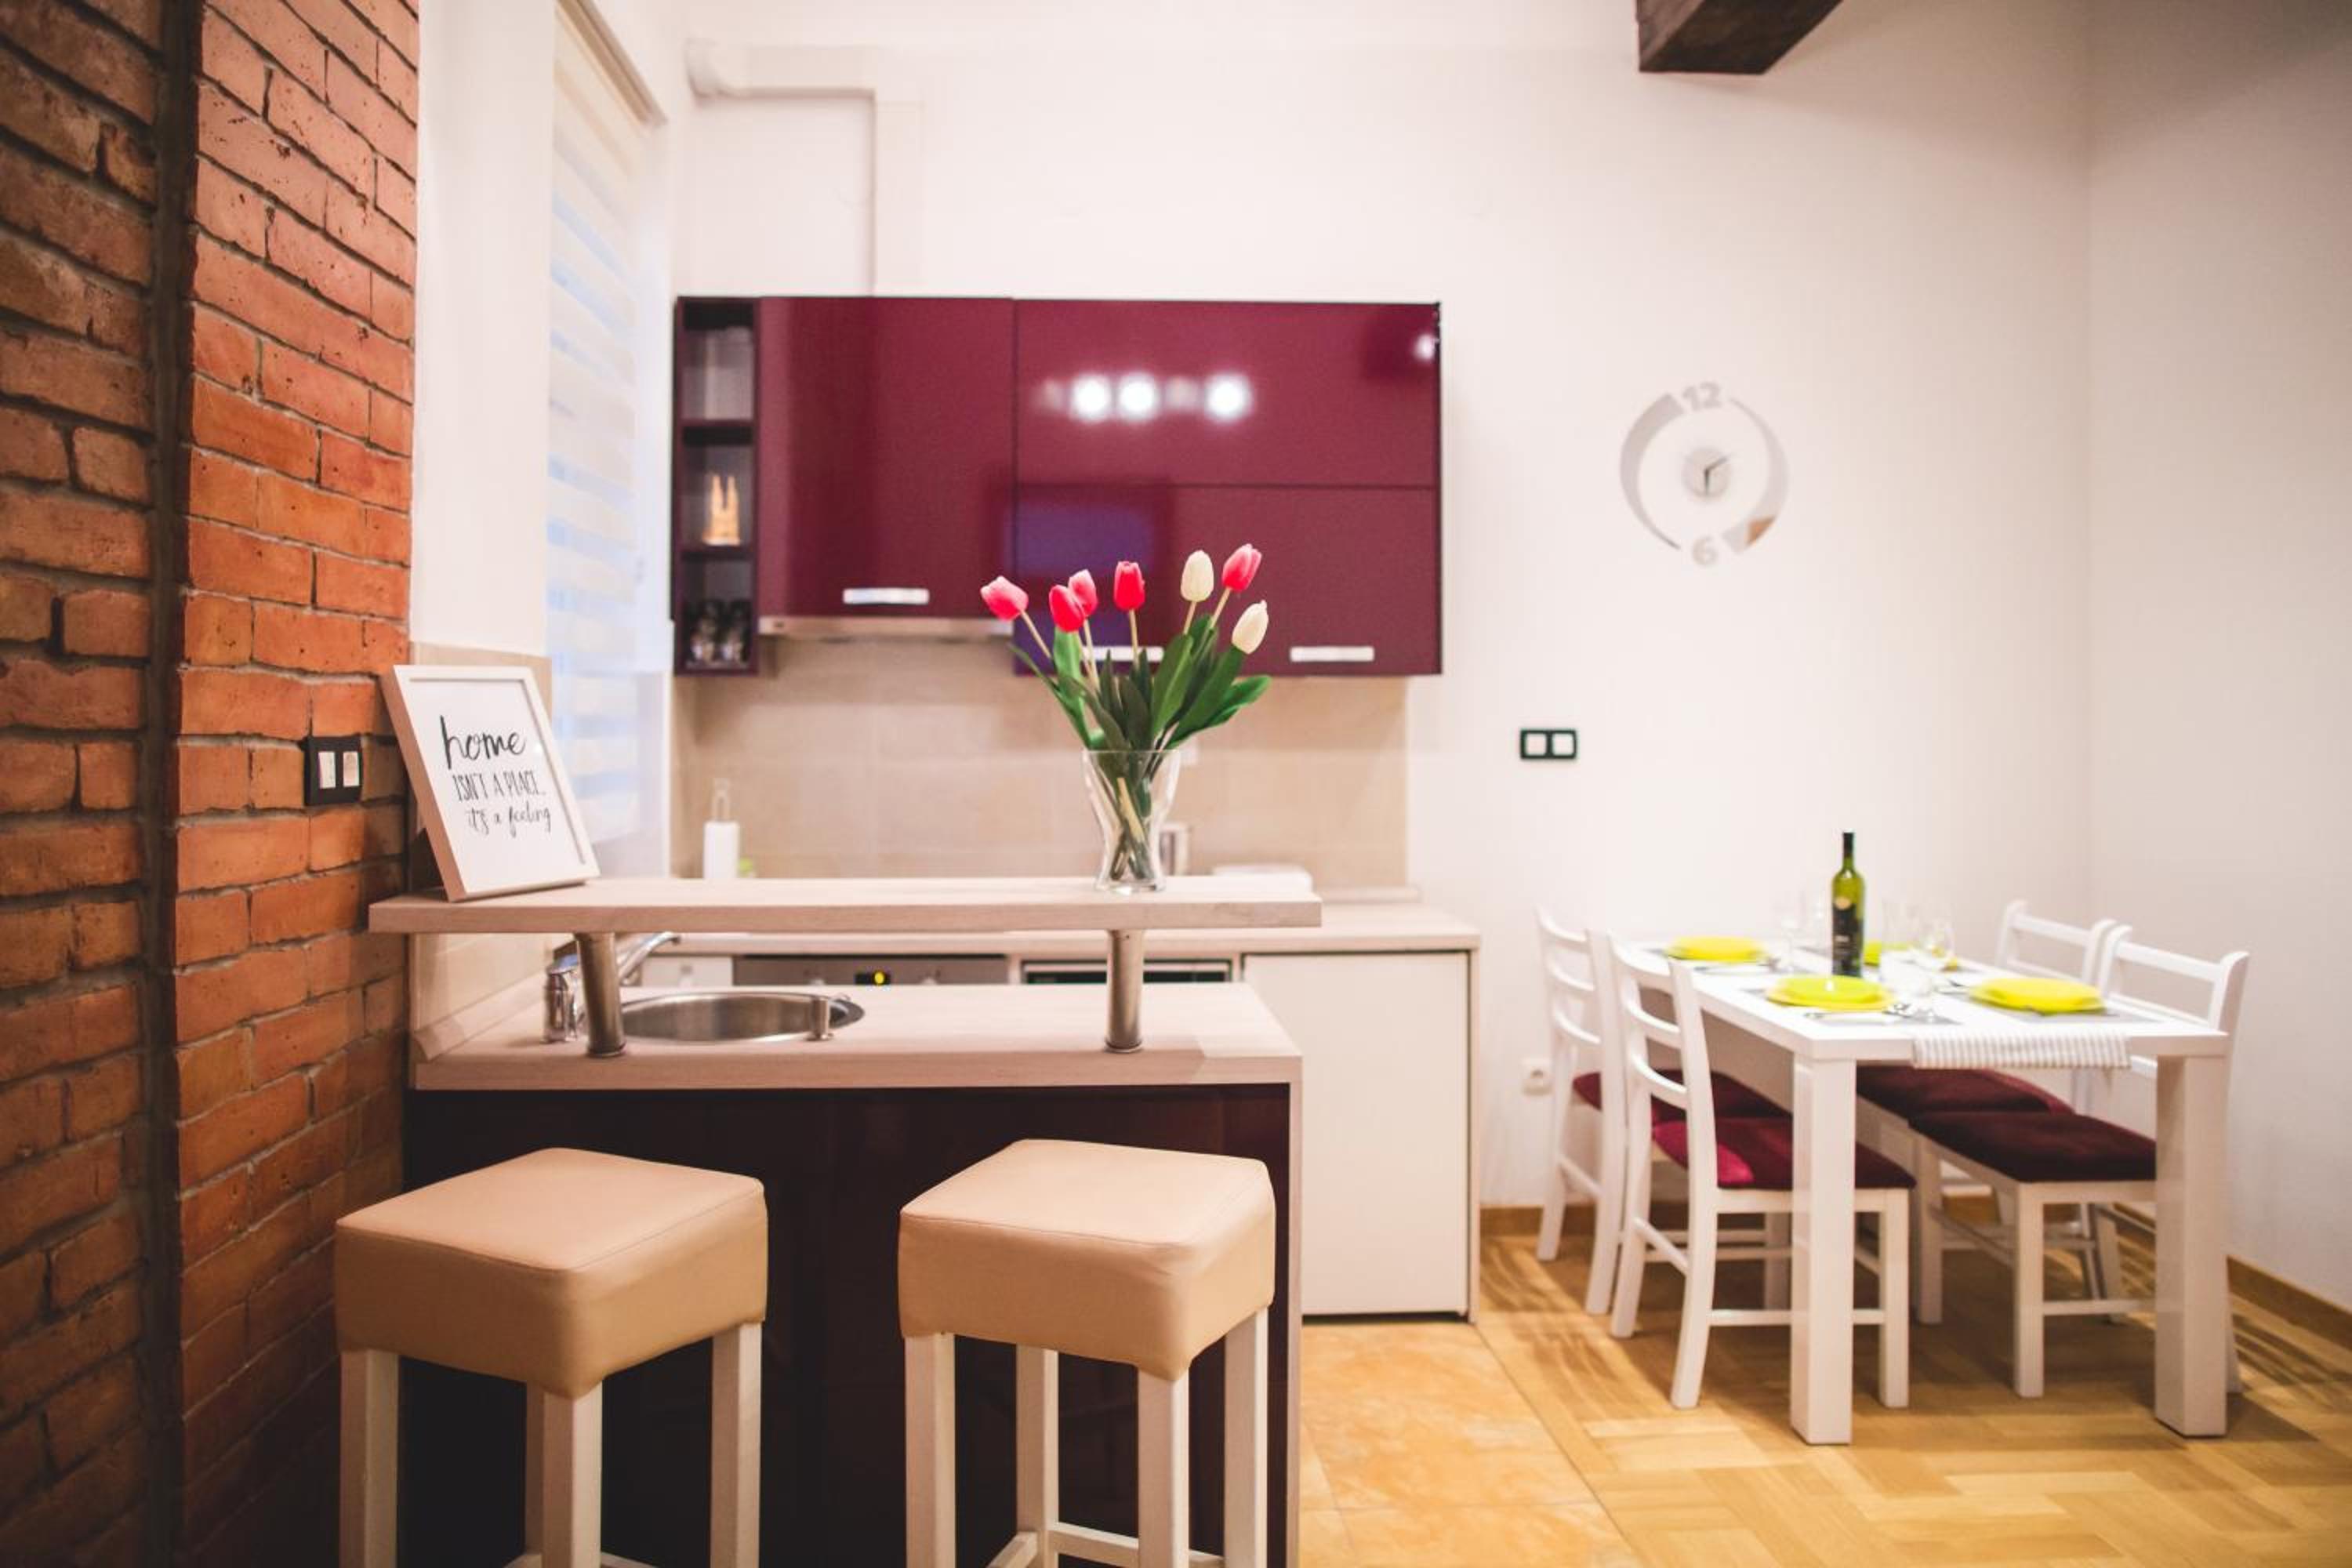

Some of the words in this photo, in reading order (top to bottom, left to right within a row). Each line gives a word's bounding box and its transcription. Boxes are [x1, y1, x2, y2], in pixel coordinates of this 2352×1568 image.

[1682, 382, 1722, 412] 12
[1692, 535, 1719, 567] 6
[440, 715, 526, 770] home
[493, 771, 505, 797] A
[494, 813, 502, 825] a
[509, 800, 551, 838] feeling
